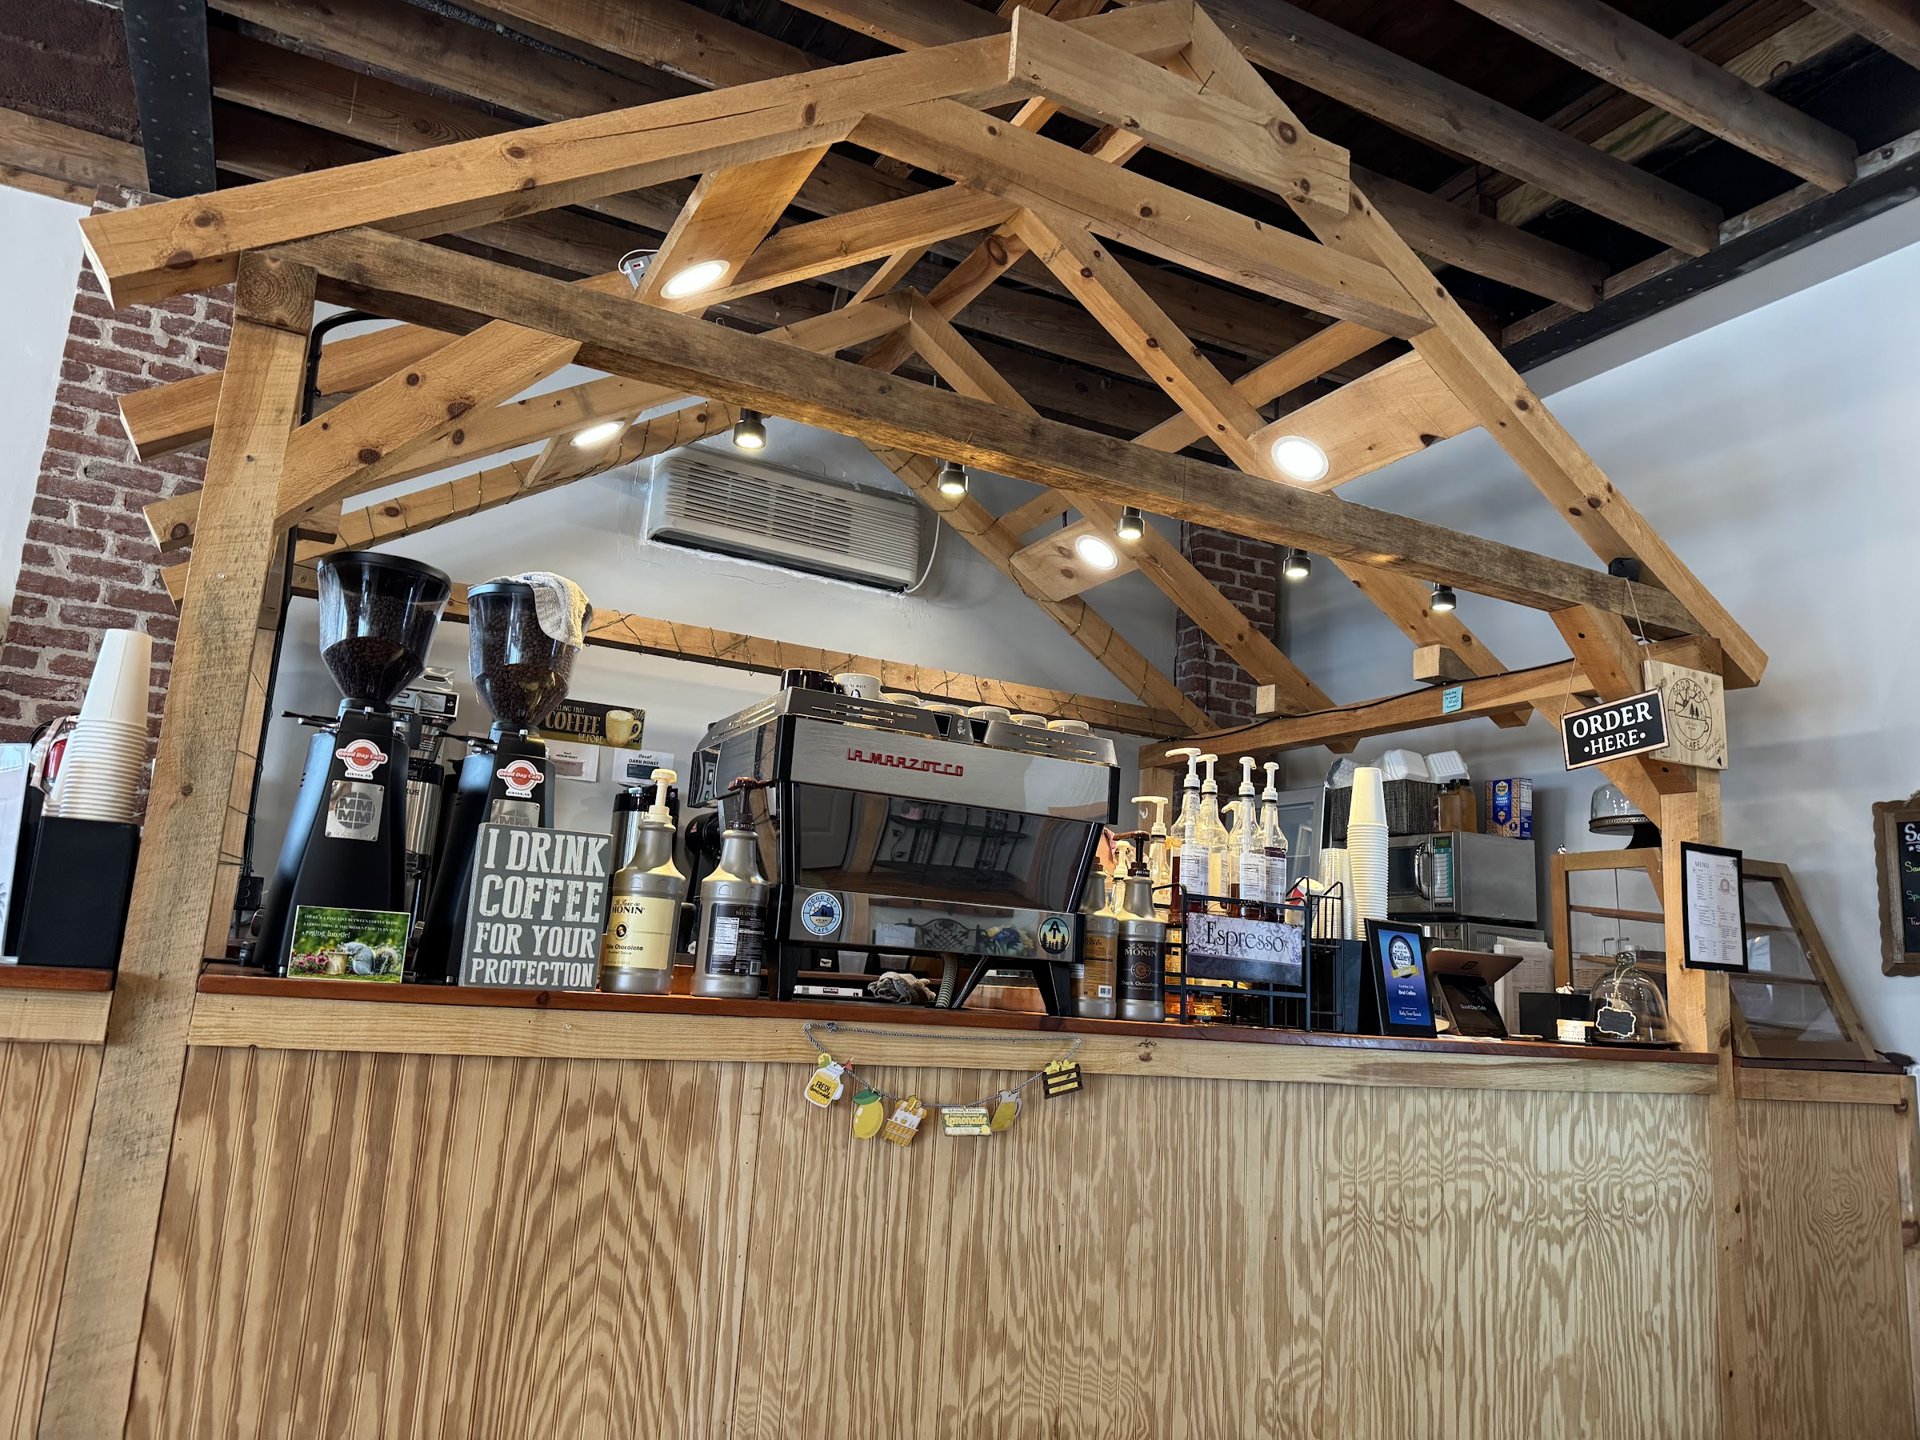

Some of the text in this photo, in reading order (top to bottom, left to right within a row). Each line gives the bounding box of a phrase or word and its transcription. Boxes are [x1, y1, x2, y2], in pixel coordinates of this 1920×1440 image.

[1672, 680, 1691, 697] GOOD
[546, 710, 601, 735] COFFEE
[1573, 702, 1653, 739] ORDER
[577, 732, 604, 744] BEFORE
[1684, 740, 1701, 752] CAFE
[356, 752, 369, 760] Day
[870, 751, 964, 777] MARZOCCO
[484, 828, 608, 877] I DRINK
[478, 874, 604, 923] COFFEE
[807, 895, 825, 908] GOOD
[473, 922, 597, 959] FOR YOUR
[1205, 920, 1285, 955] Espresso
[1124, 948, 1158, 957] MONIN
[469, 957, 595, 988] PROTECTION
[815, 1080, 831, 1093] FRESH
[944, 1113, 988, 1127] Lemonade
